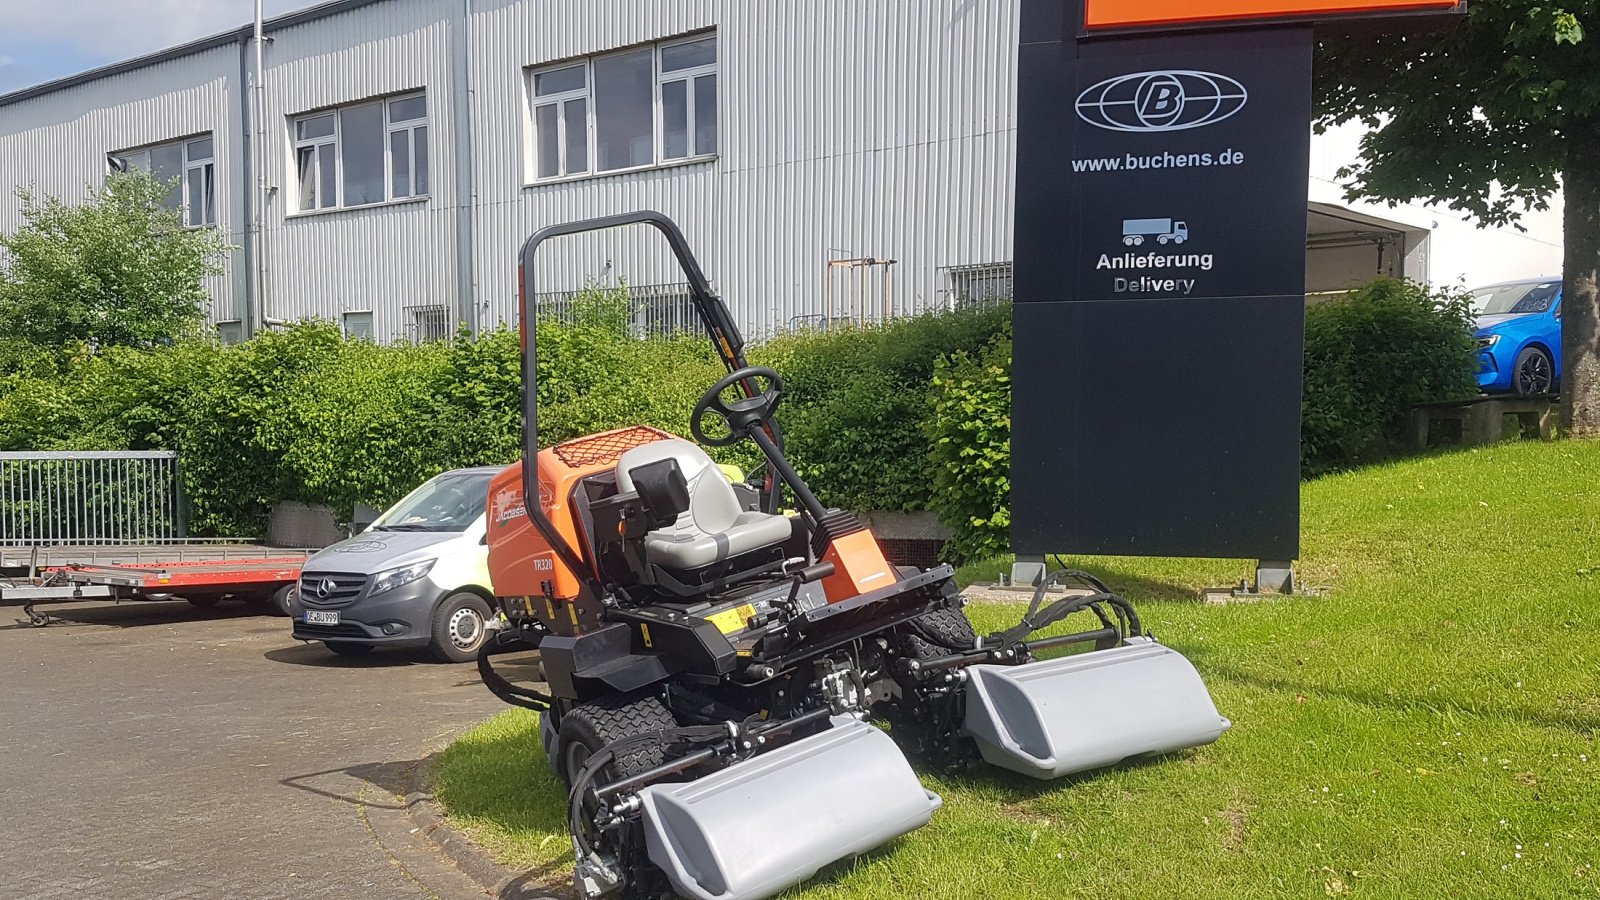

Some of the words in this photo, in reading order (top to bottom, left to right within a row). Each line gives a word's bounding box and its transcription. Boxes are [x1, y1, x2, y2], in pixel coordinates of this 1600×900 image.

[1072, 148, 1244, 172] www.buchens.de
[1096, 252, 1213, 271] Anlieferung
[1114, 276, 1195, 295] Delivery
[533, 559, 553, 571] TR320
